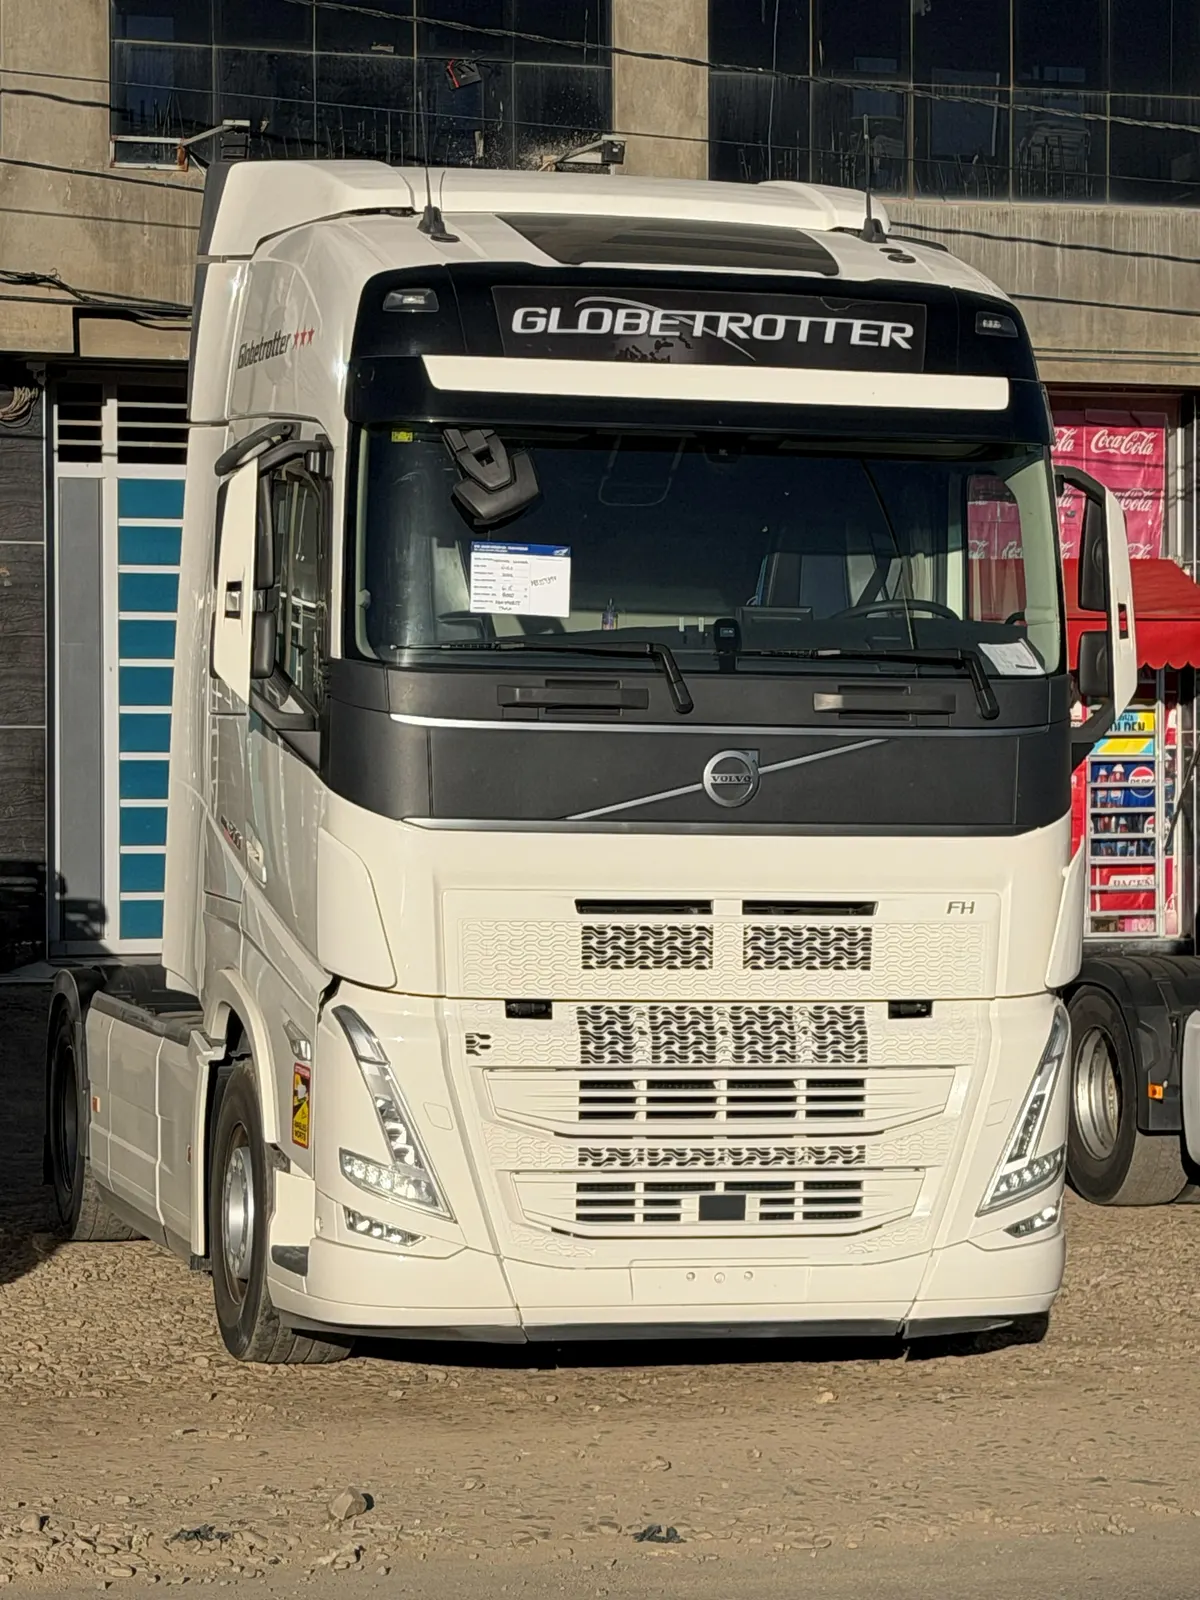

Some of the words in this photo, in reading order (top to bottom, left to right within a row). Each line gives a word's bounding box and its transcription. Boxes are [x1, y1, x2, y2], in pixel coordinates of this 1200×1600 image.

[512, 305, 914, 350] GLOBETROTTER
[237, 329, 292, 370] Globetrotter
[1090, 428, 1159, 455] Coca-Cola
[711, 775, 752, 783] VOLVO
[946, 900, 976, 915] FH
